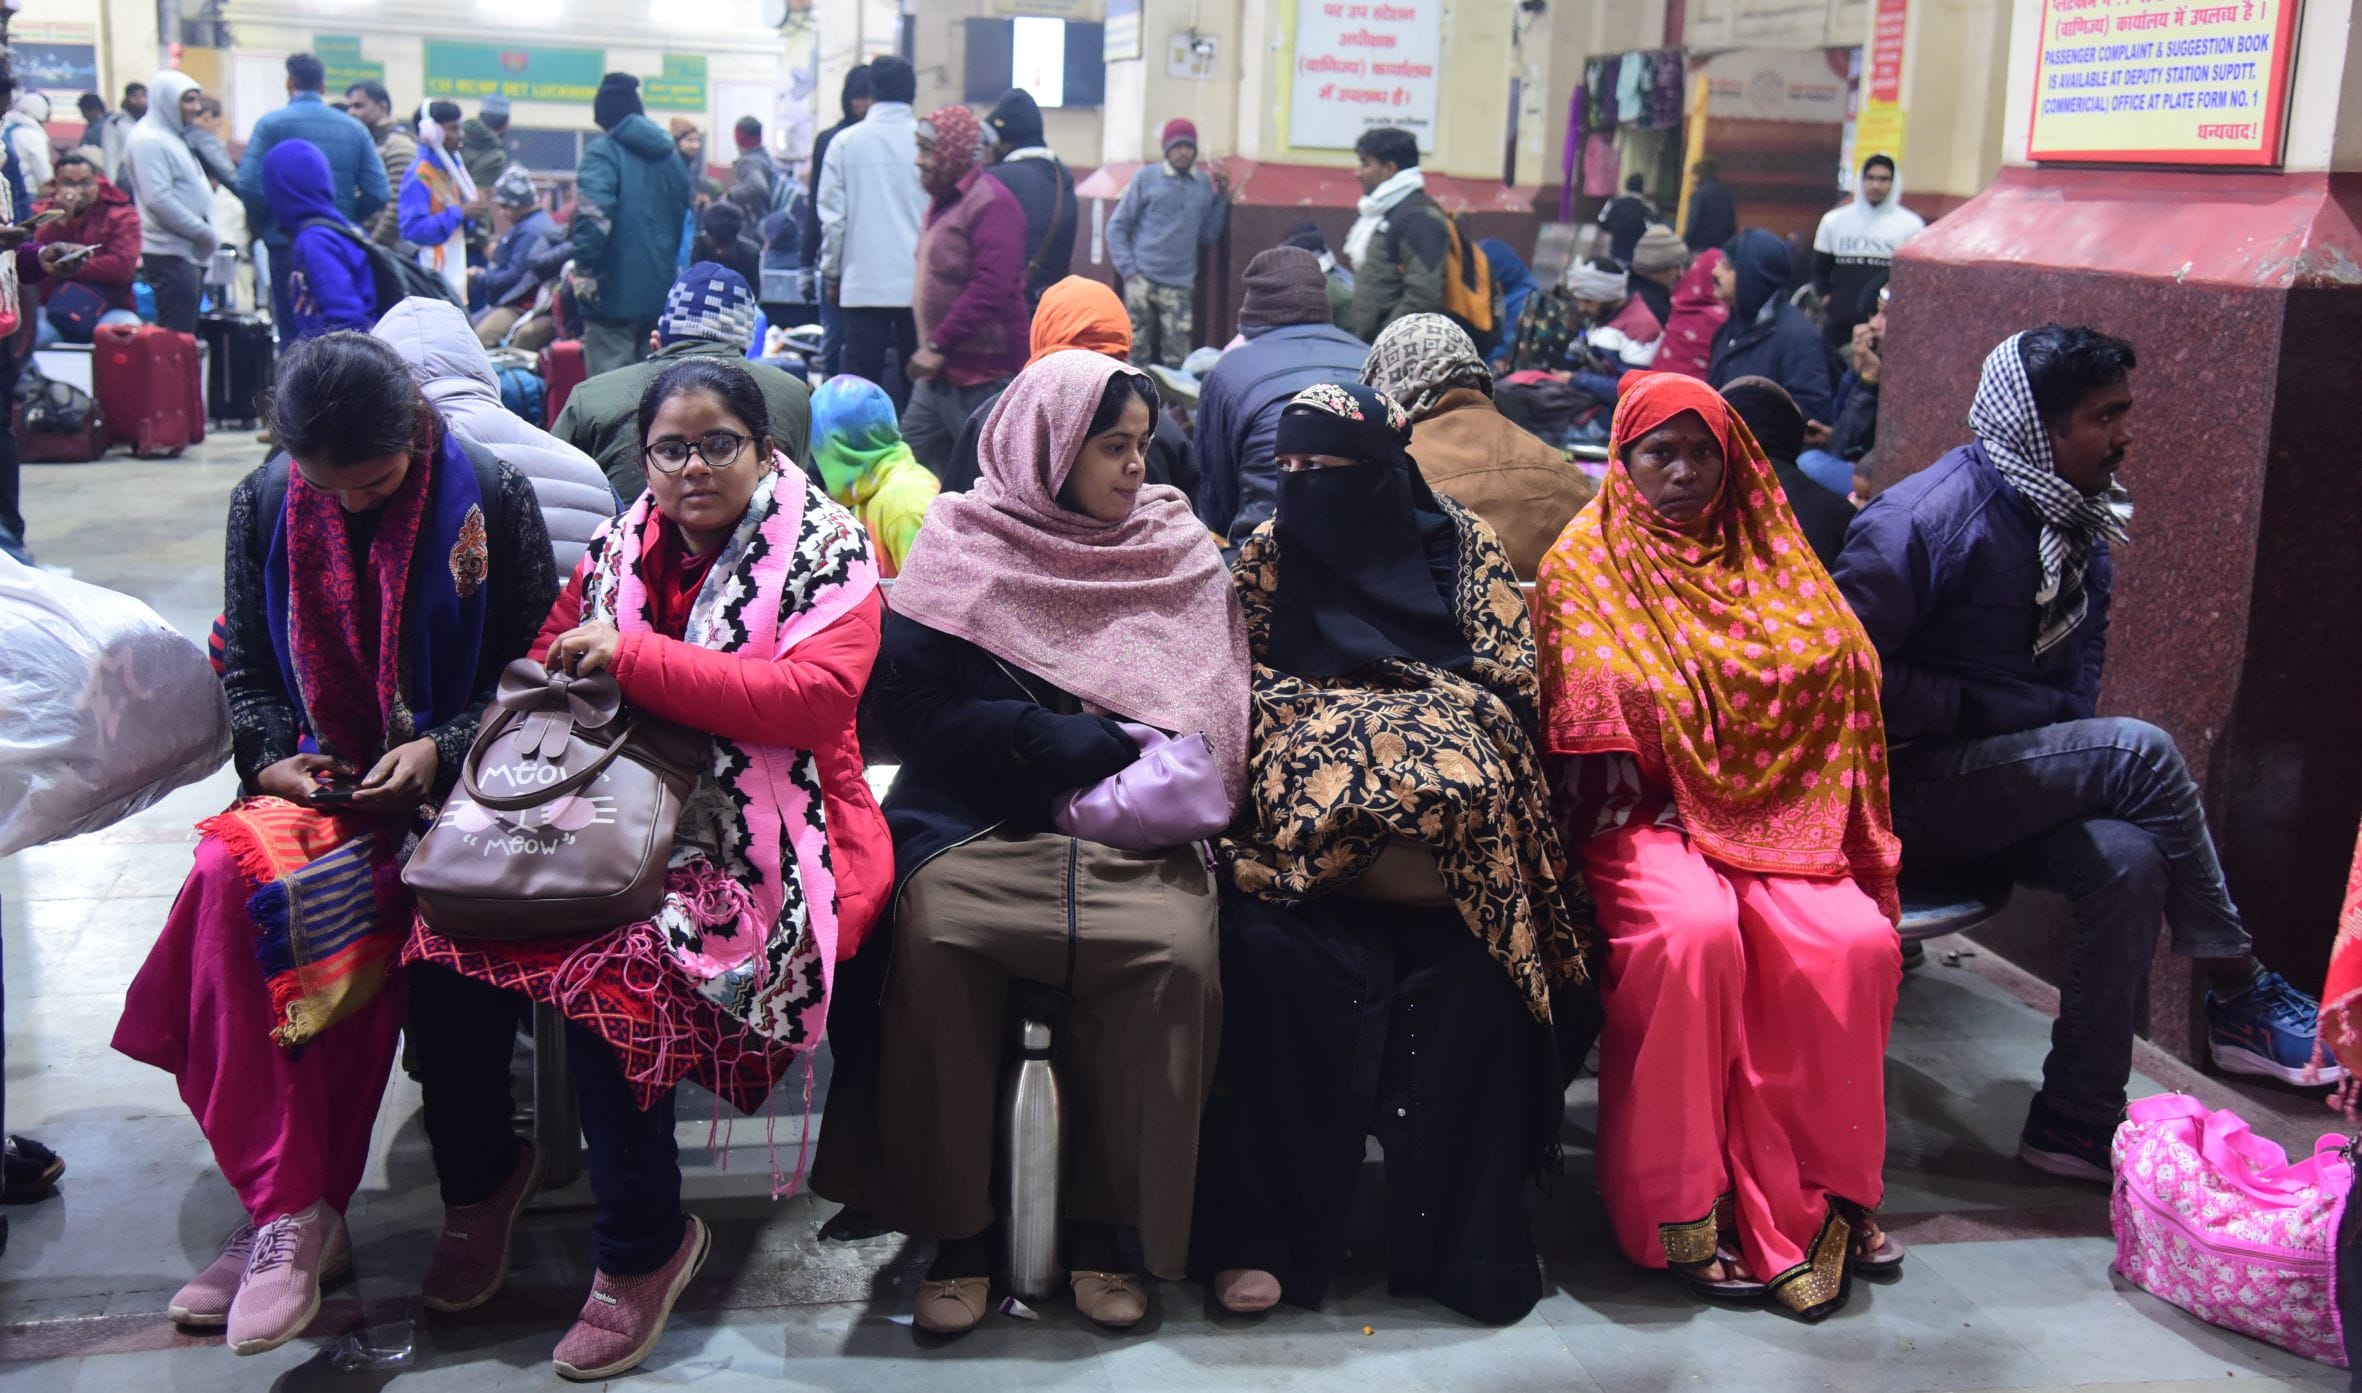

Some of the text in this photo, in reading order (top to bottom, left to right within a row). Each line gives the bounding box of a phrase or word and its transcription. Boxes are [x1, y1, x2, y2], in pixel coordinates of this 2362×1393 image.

[2116, 9, 2169, 30] कार्यालय
[2174, 5, 2188, 26] में
[2044, 33, 2269, 66] PASSENGER COMPLAINT & SUGGESTION BOOK
[2048, 62, 2256, 91] IS AVAILABLE AT DEPUTY STATION SUPDTT.
[2111, 94, 2146, 112] OFFICE
[2147, 93, 2161, 110] AT
[2162, 92, 2195, 110] PLATE
[2197, 90, 2228, 109] FORM
[2229, 90, 2249, 108] NO.
[2252, 89, 2259, 107] 1
[1839, 237, 1895, 252] BOSS
